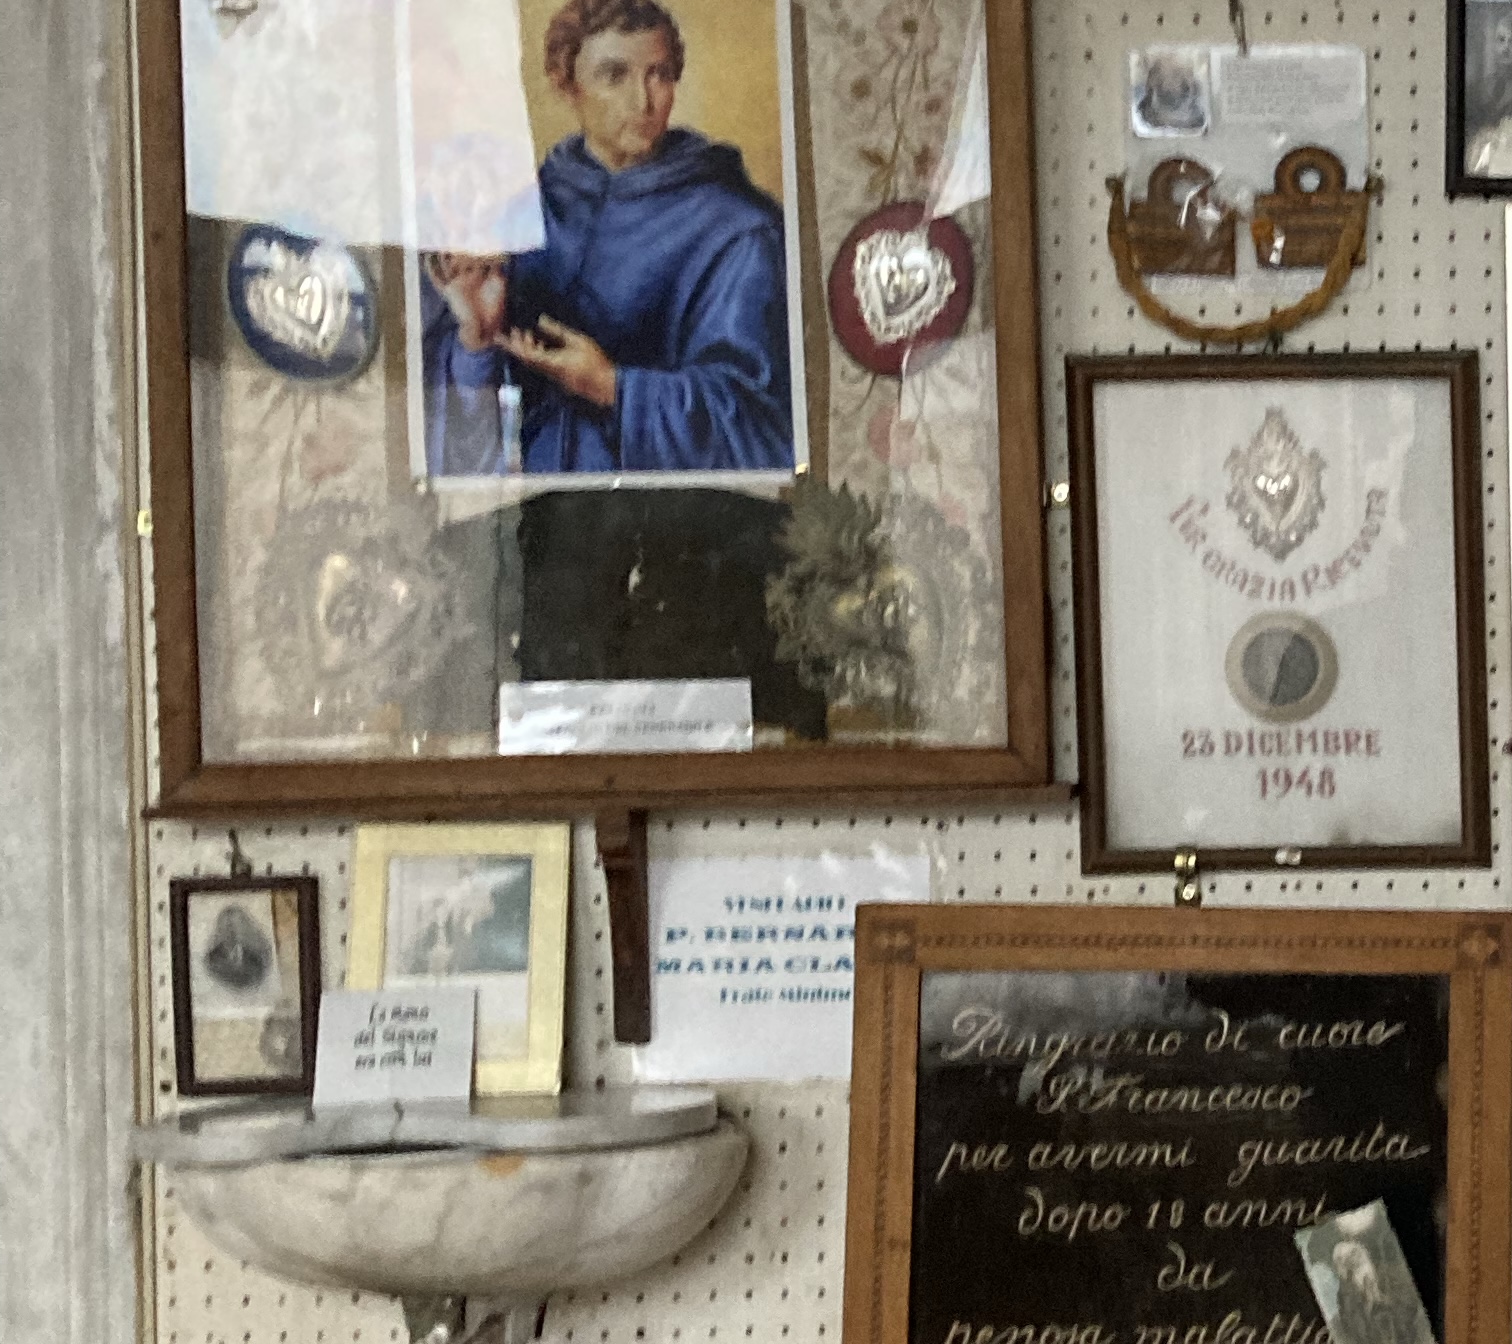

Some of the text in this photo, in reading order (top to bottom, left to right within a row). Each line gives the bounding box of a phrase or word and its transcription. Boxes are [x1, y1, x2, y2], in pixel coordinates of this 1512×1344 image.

[1223, 726, 1380, 757] DICEMBRE
[1204, 1008, 1248, 1054] di
[1278, 1021, 1403, 1050] cuore
[935, 1122, 1430, 1188] per avermi guarita
[1017, 1186, 1128, 1243] dopo
[1157, 1240, 1233, 1292] da
